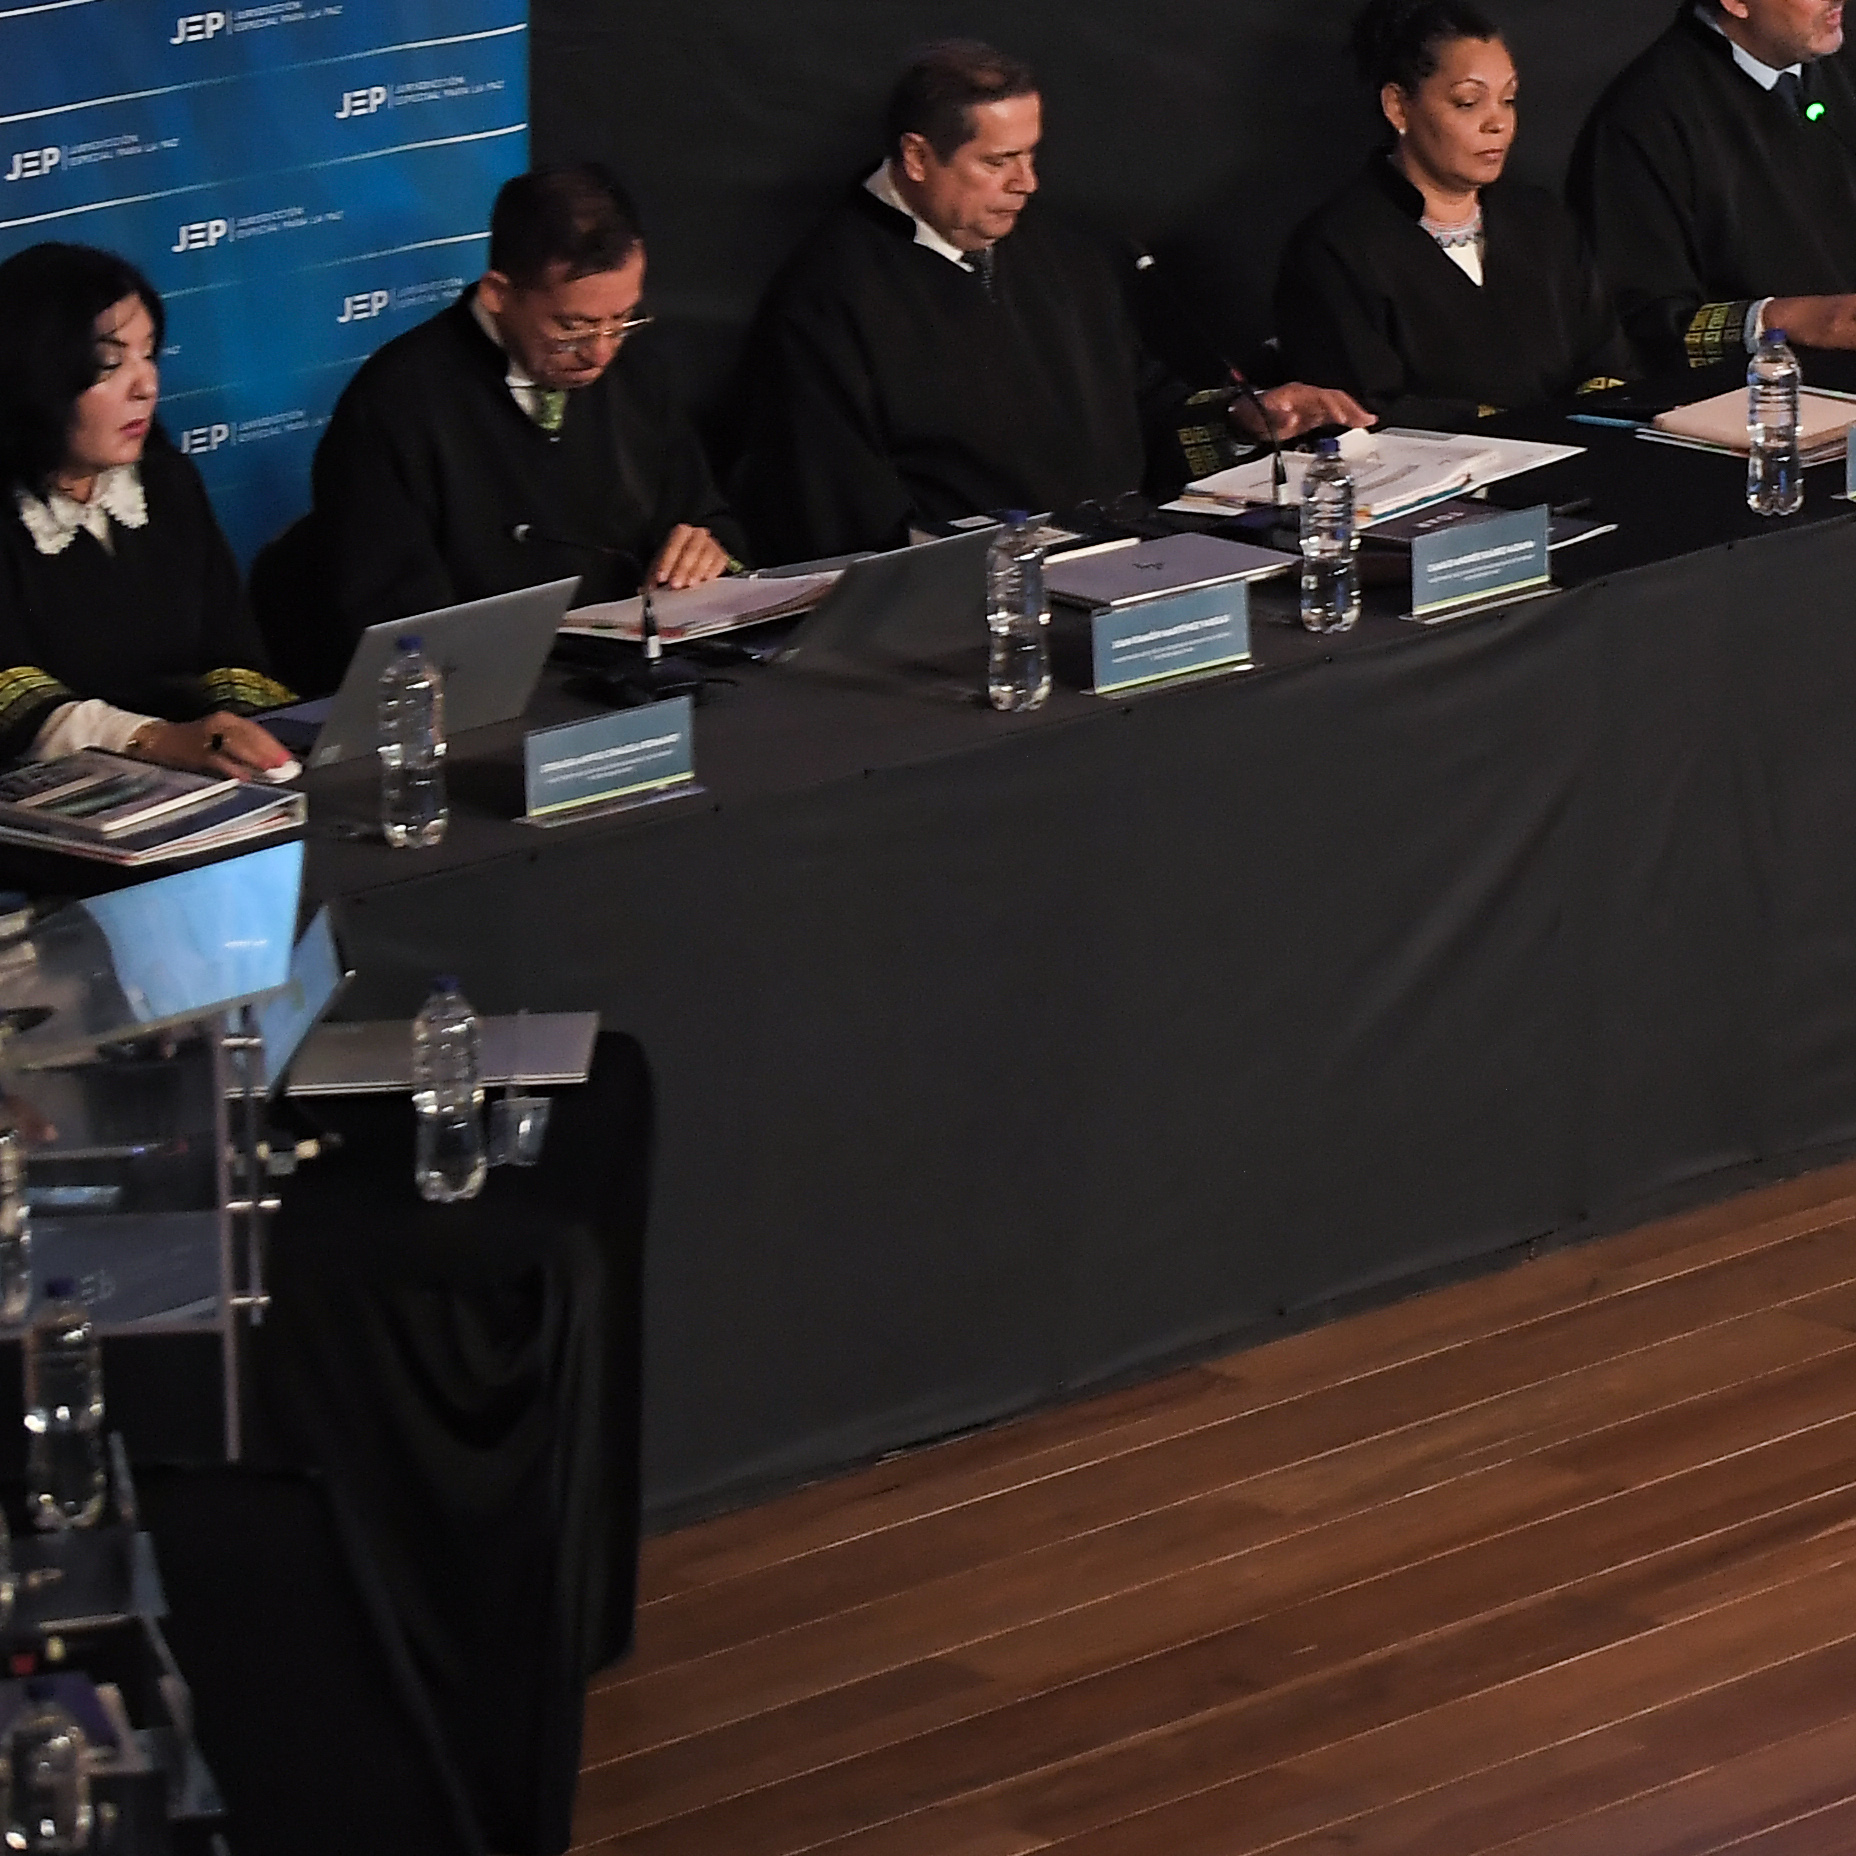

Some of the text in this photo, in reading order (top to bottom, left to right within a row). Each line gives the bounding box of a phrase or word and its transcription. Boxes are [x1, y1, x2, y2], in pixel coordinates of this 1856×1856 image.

[169, 12, 226, 45] JEP
[335, 87, 387, 119] JEP
[4, 147, 61, 181] JEP
[171, 220, 228, 253] JEP
[337, 290, 390, 323] JEP
